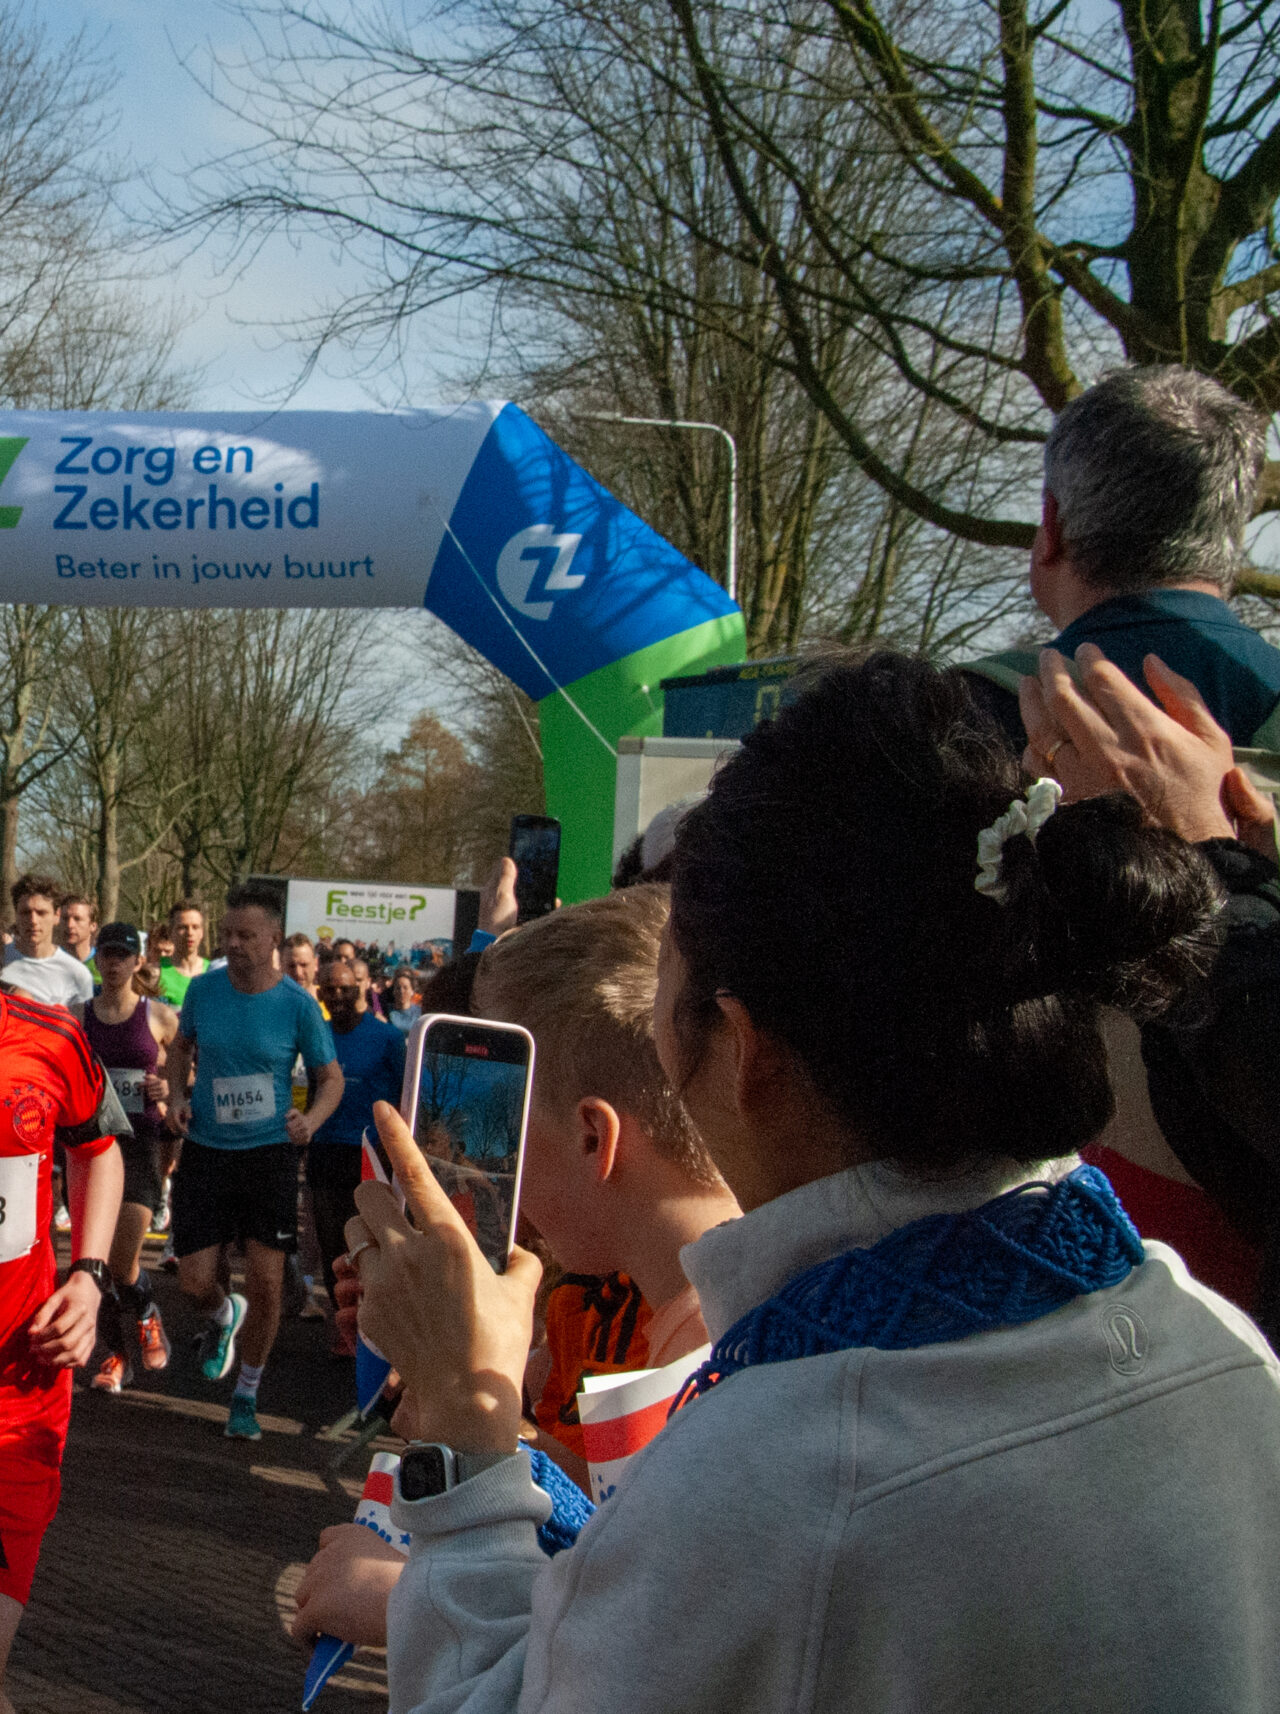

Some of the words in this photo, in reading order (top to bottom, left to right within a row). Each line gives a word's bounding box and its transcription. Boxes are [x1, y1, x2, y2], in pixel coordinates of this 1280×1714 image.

[54, 436, 176, 486] Zorg
[192, 444, 255, 475] en
[53, 482, 320, 531] Zekerheid
[55, 554, 141, 580] Beter
[152, 555, 181, 579] in
[191, 554, 272, 584] jouw
[283, 554, 376, 580] buurt
[326, 889, 427, 925] Feestje?
[216, 1089, 263, 1107] M1654
